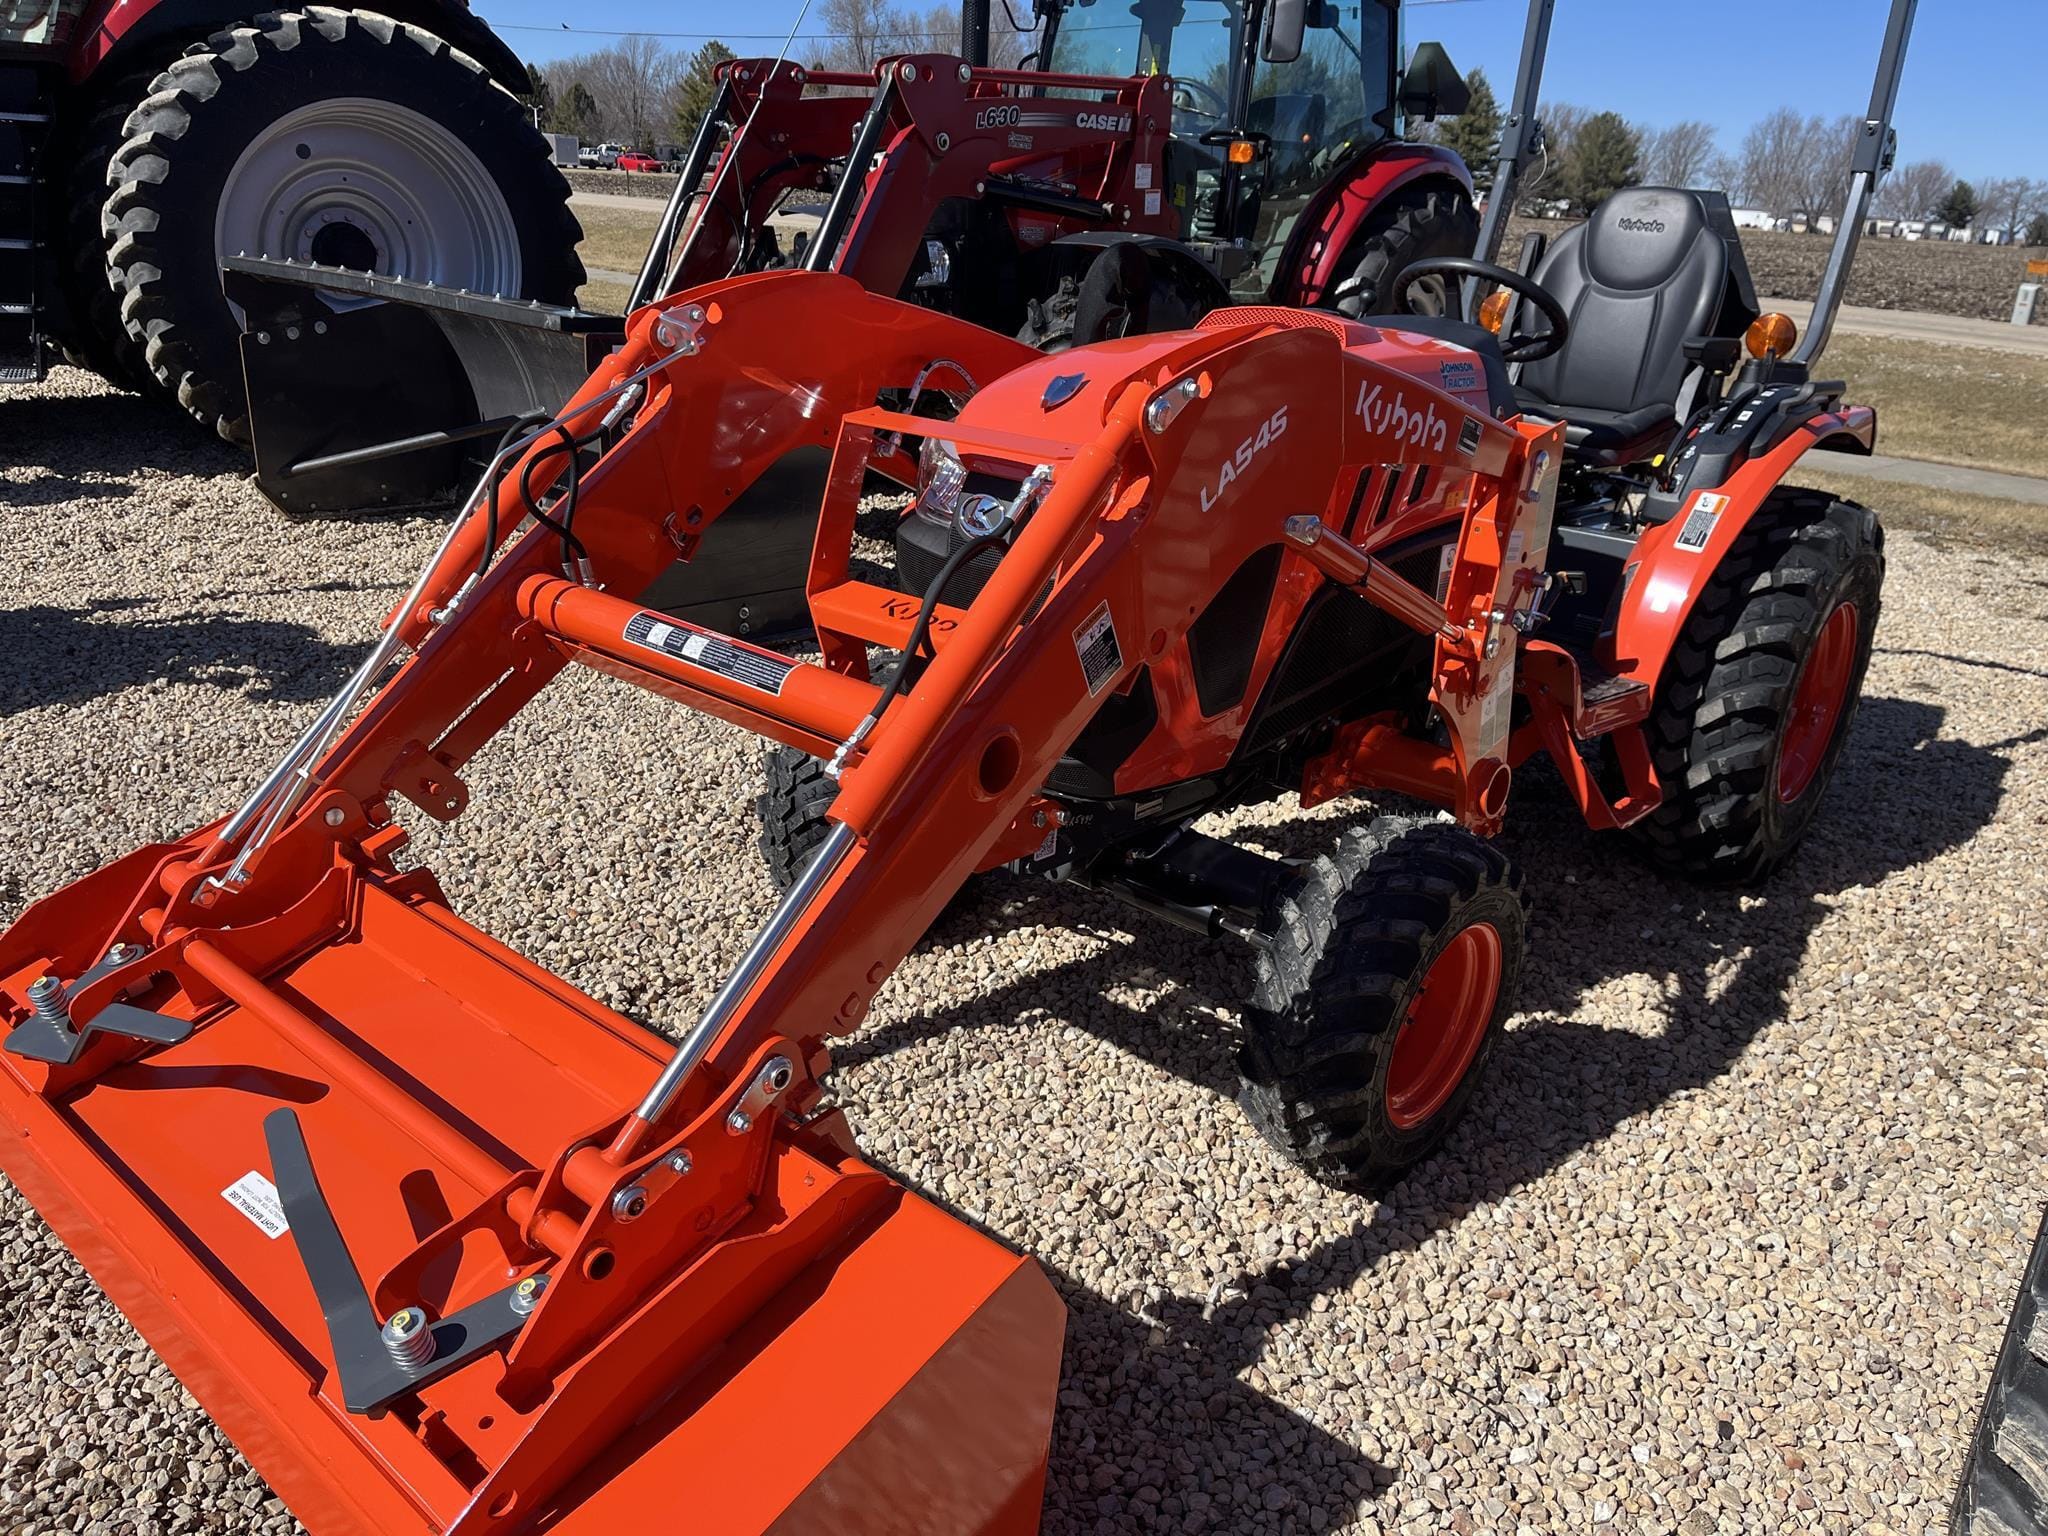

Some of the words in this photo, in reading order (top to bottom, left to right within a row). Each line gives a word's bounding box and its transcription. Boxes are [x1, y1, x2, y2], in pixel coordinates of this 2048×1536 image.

[976, 105, 1021, 129] L630
[1076, 112, 1118, 130] CASE
[1618, 217, 1665, 233] Kubota
[1440, 360, 1474, 373] JOHNSON
[1442, 374, 1476, 388] TRACTOR
[1355, 380, 1447, 452] Kubota
[1200, 404, 1288, 513] LA545
[228, 1190, 242, 1202] USE
[240, 1198, 264, 1221] MATERIAL
[260, 1216, 279, 1233] LIGHT
